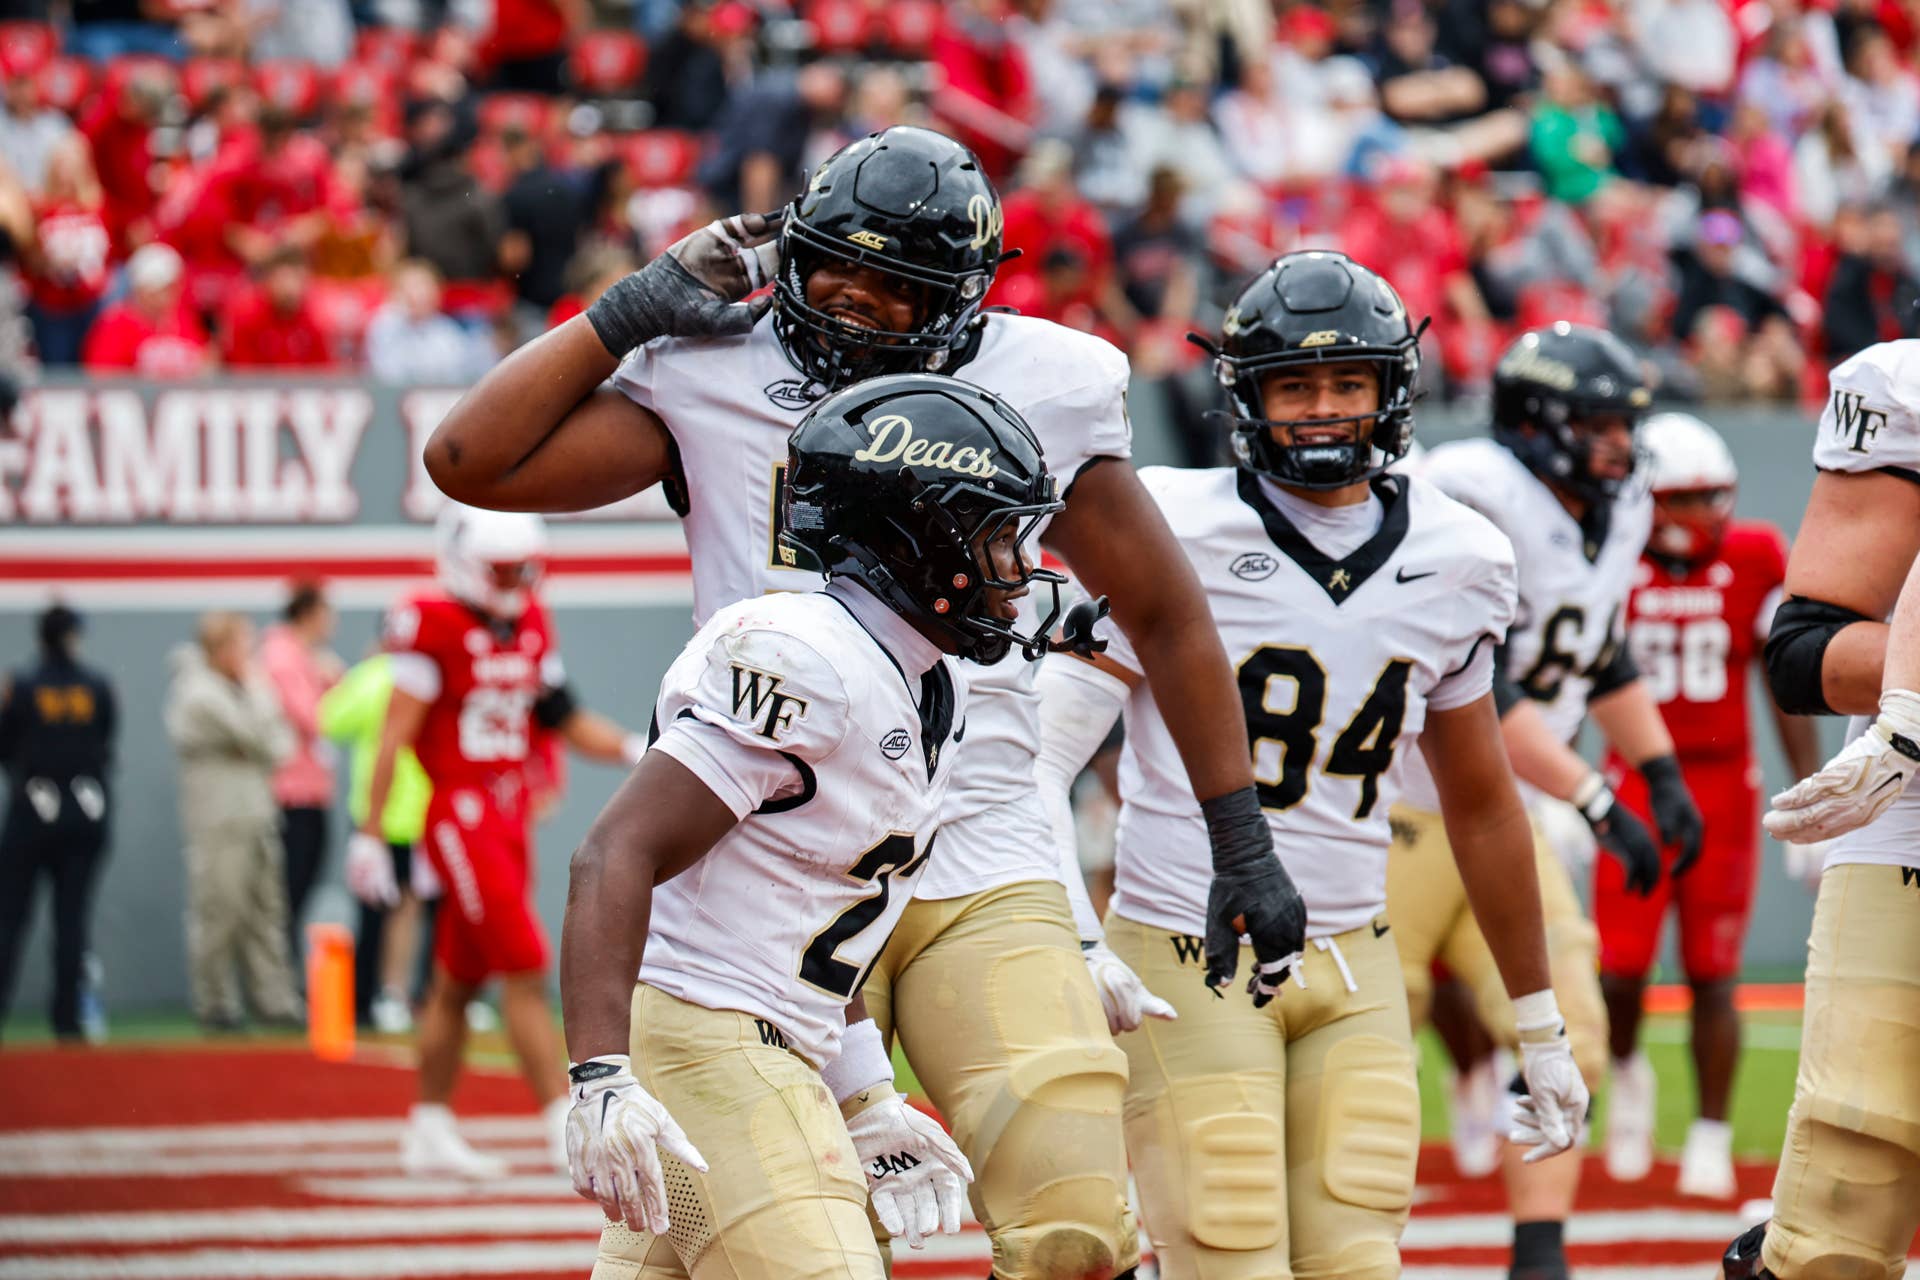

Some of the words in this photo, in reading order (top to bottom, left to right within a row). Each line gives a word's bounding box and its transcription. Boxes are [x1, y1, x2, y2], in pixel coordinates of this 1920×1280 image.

[847, 230, 888, 251] ACC
[1300, 330, 1340, 348] ACC
[1834, 389, 1887, 454] WF
[855, 415, 999, 478] Deacs
[1239, 559, 1270, 572] ACC
[730, 663, 808, 742] WF
[884, 735, 909, 748] ACC
[1235, 642, 1416, 821] 84
